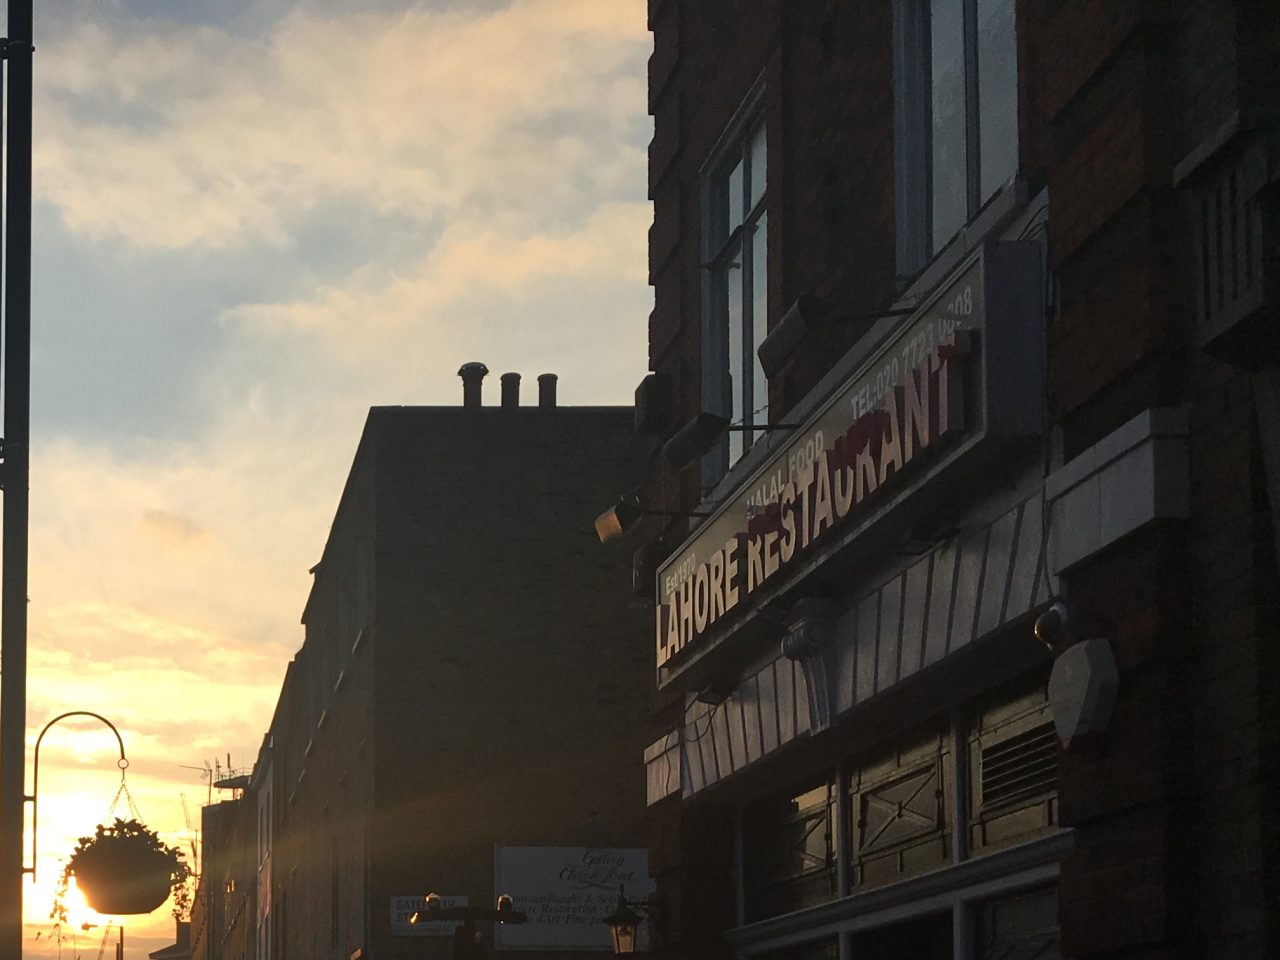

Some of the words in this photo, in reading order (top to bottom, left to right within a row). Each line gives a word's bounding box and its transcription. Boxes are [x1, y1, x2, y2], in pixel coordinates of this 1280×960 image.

[747, 335, 956, 594] RESTAURANT
[789, 430, 824, 484] FOOD
[656, 538, 739, 668] LAHORE
